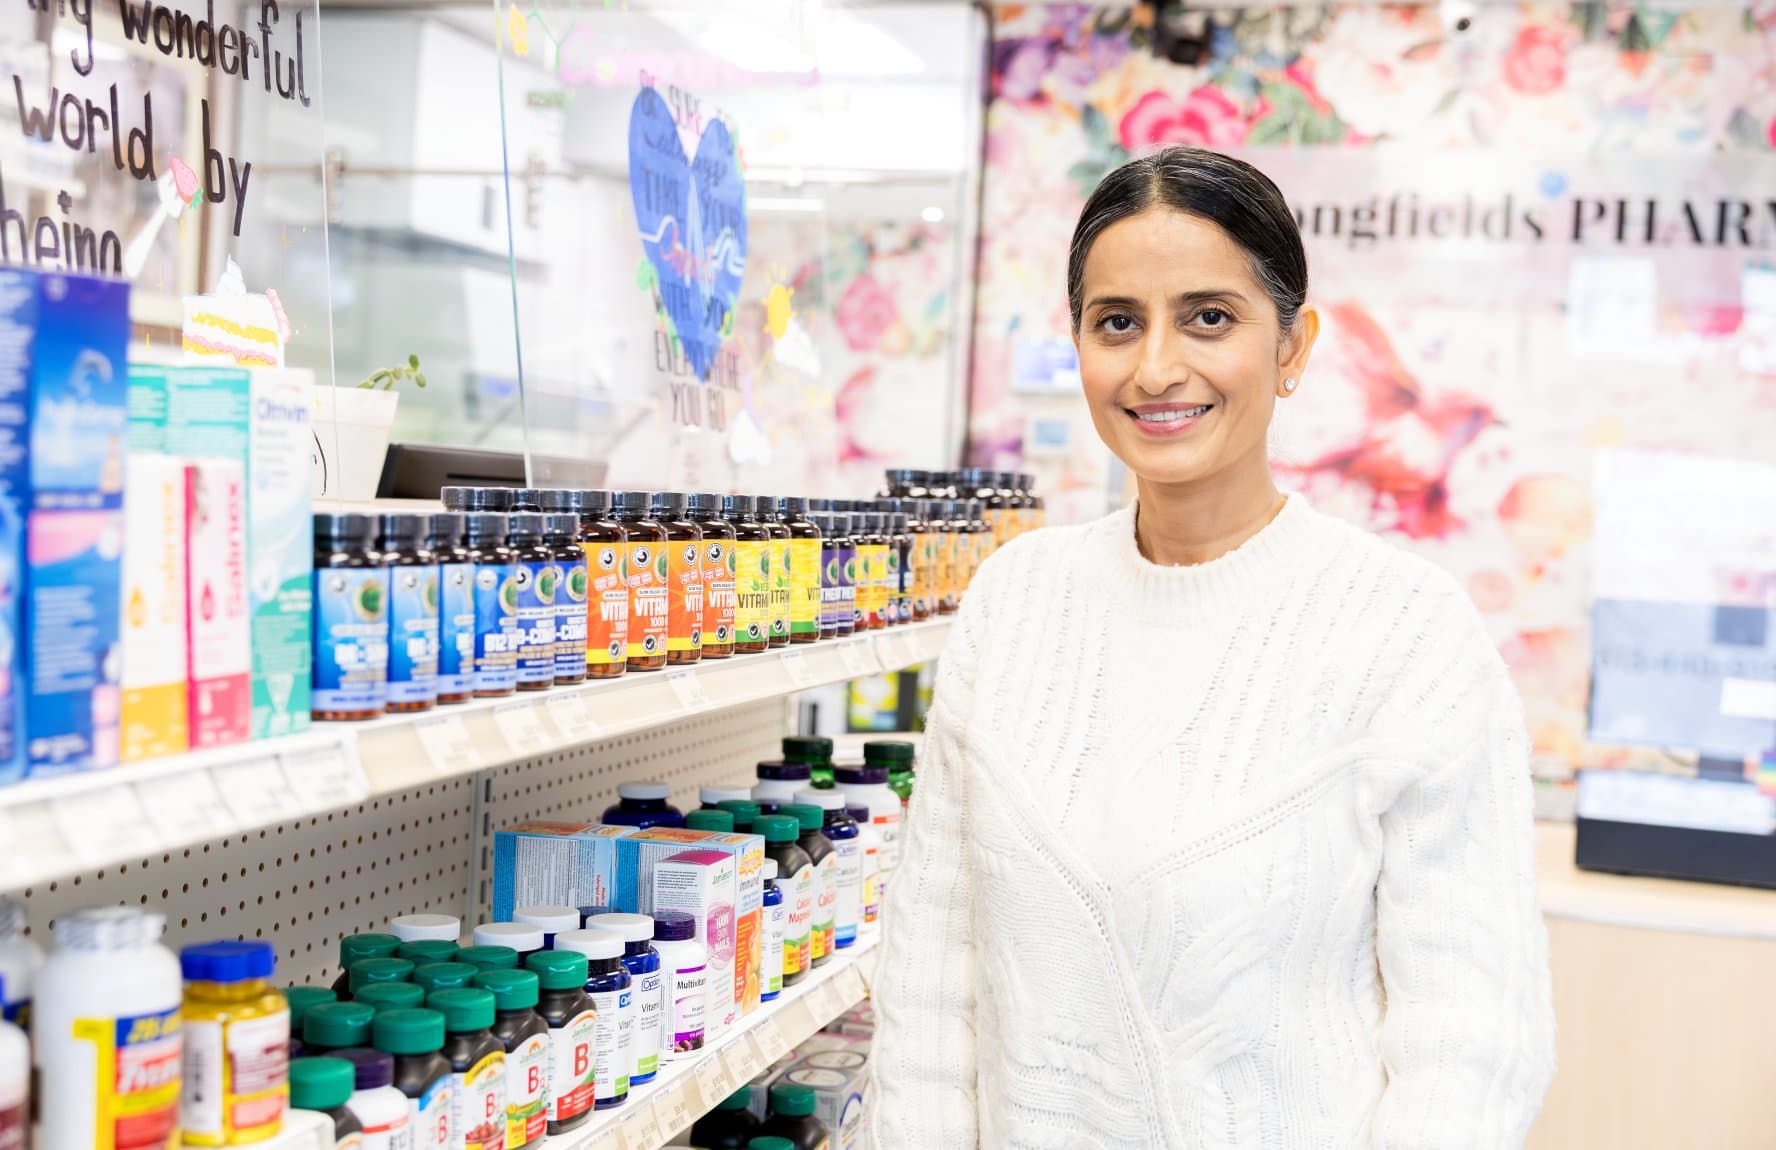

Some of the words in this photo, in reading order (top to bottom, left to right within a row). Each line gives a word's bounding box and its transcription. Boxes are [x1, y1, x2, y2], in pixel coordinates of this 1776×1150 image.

[120, 0, 311, 107] wonderful
[13, 75, 156, 181] world
[201, 99, 251, 236] by
[1571, 195, 1776, 247] PHAR
